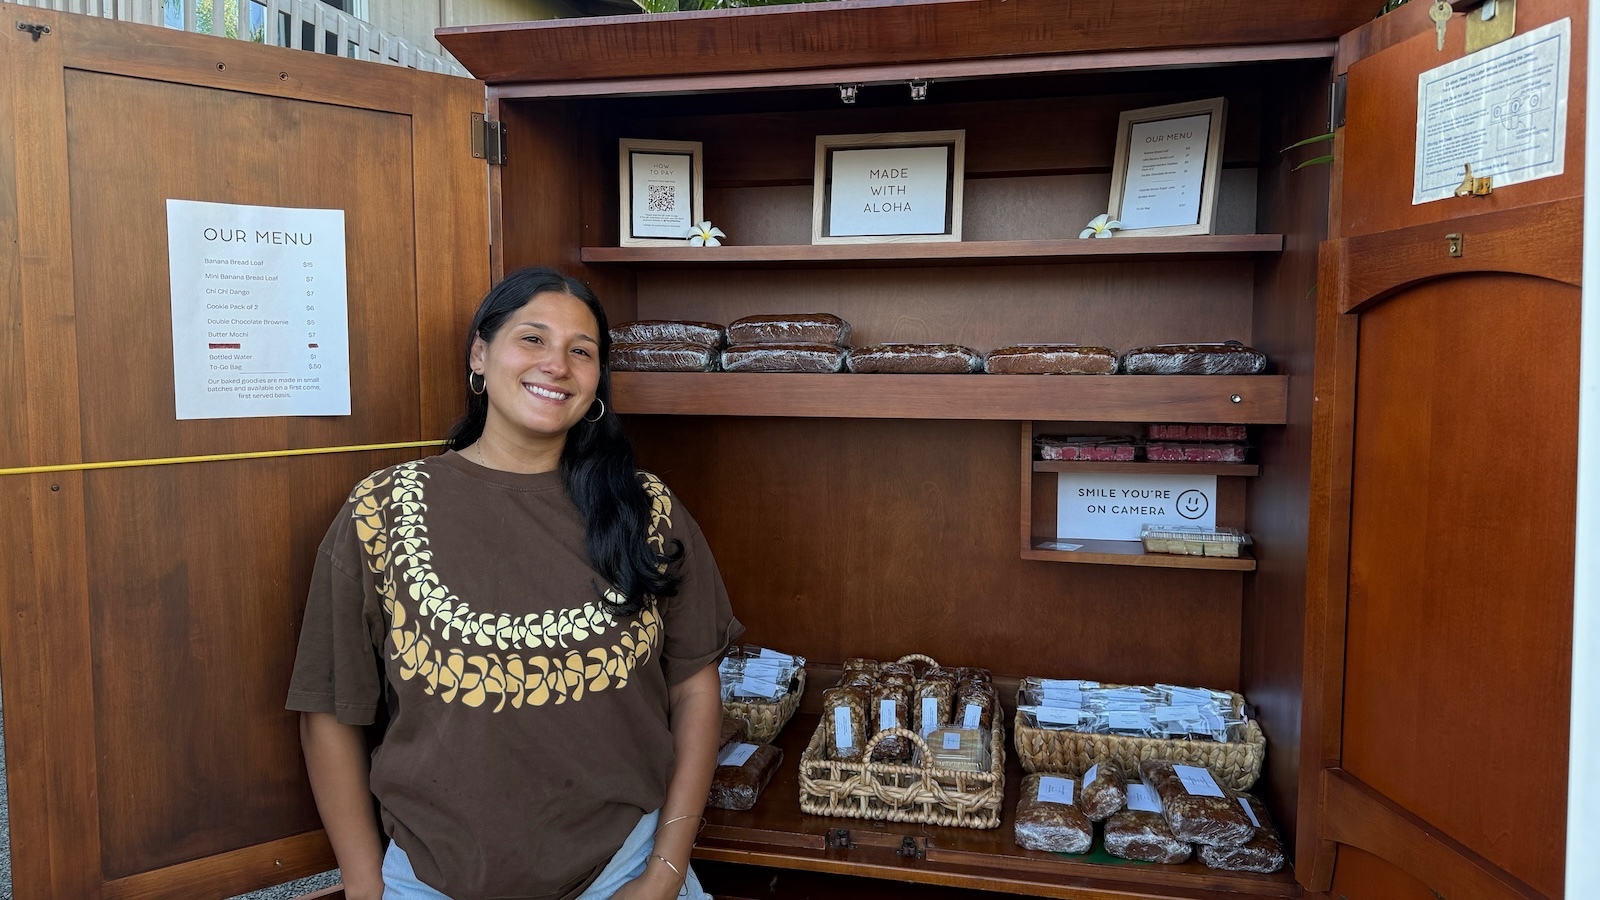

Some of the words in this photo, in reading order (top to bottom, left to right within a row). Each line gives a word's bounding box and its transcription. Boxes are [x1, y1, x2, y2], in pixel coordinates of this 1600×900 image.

[1145, 135, 1164, 144] OUR
[1166, 132, 1192, 142] MENU
[870, 168, 908, 179] MADE
[870, 185, 906, 196] WITH
[863, 202, 912, 213] ALOHA
[203, 228, 247, 243] OUR
[256, 231, 313, 245] MENU
[1078, 488, 1116, 498] SMILE
[1121, 489, 1171, 499] YOU'RE
[1087, 504, 1106, 514] ON
[1111, 505, 1165, 515] CAMERA
